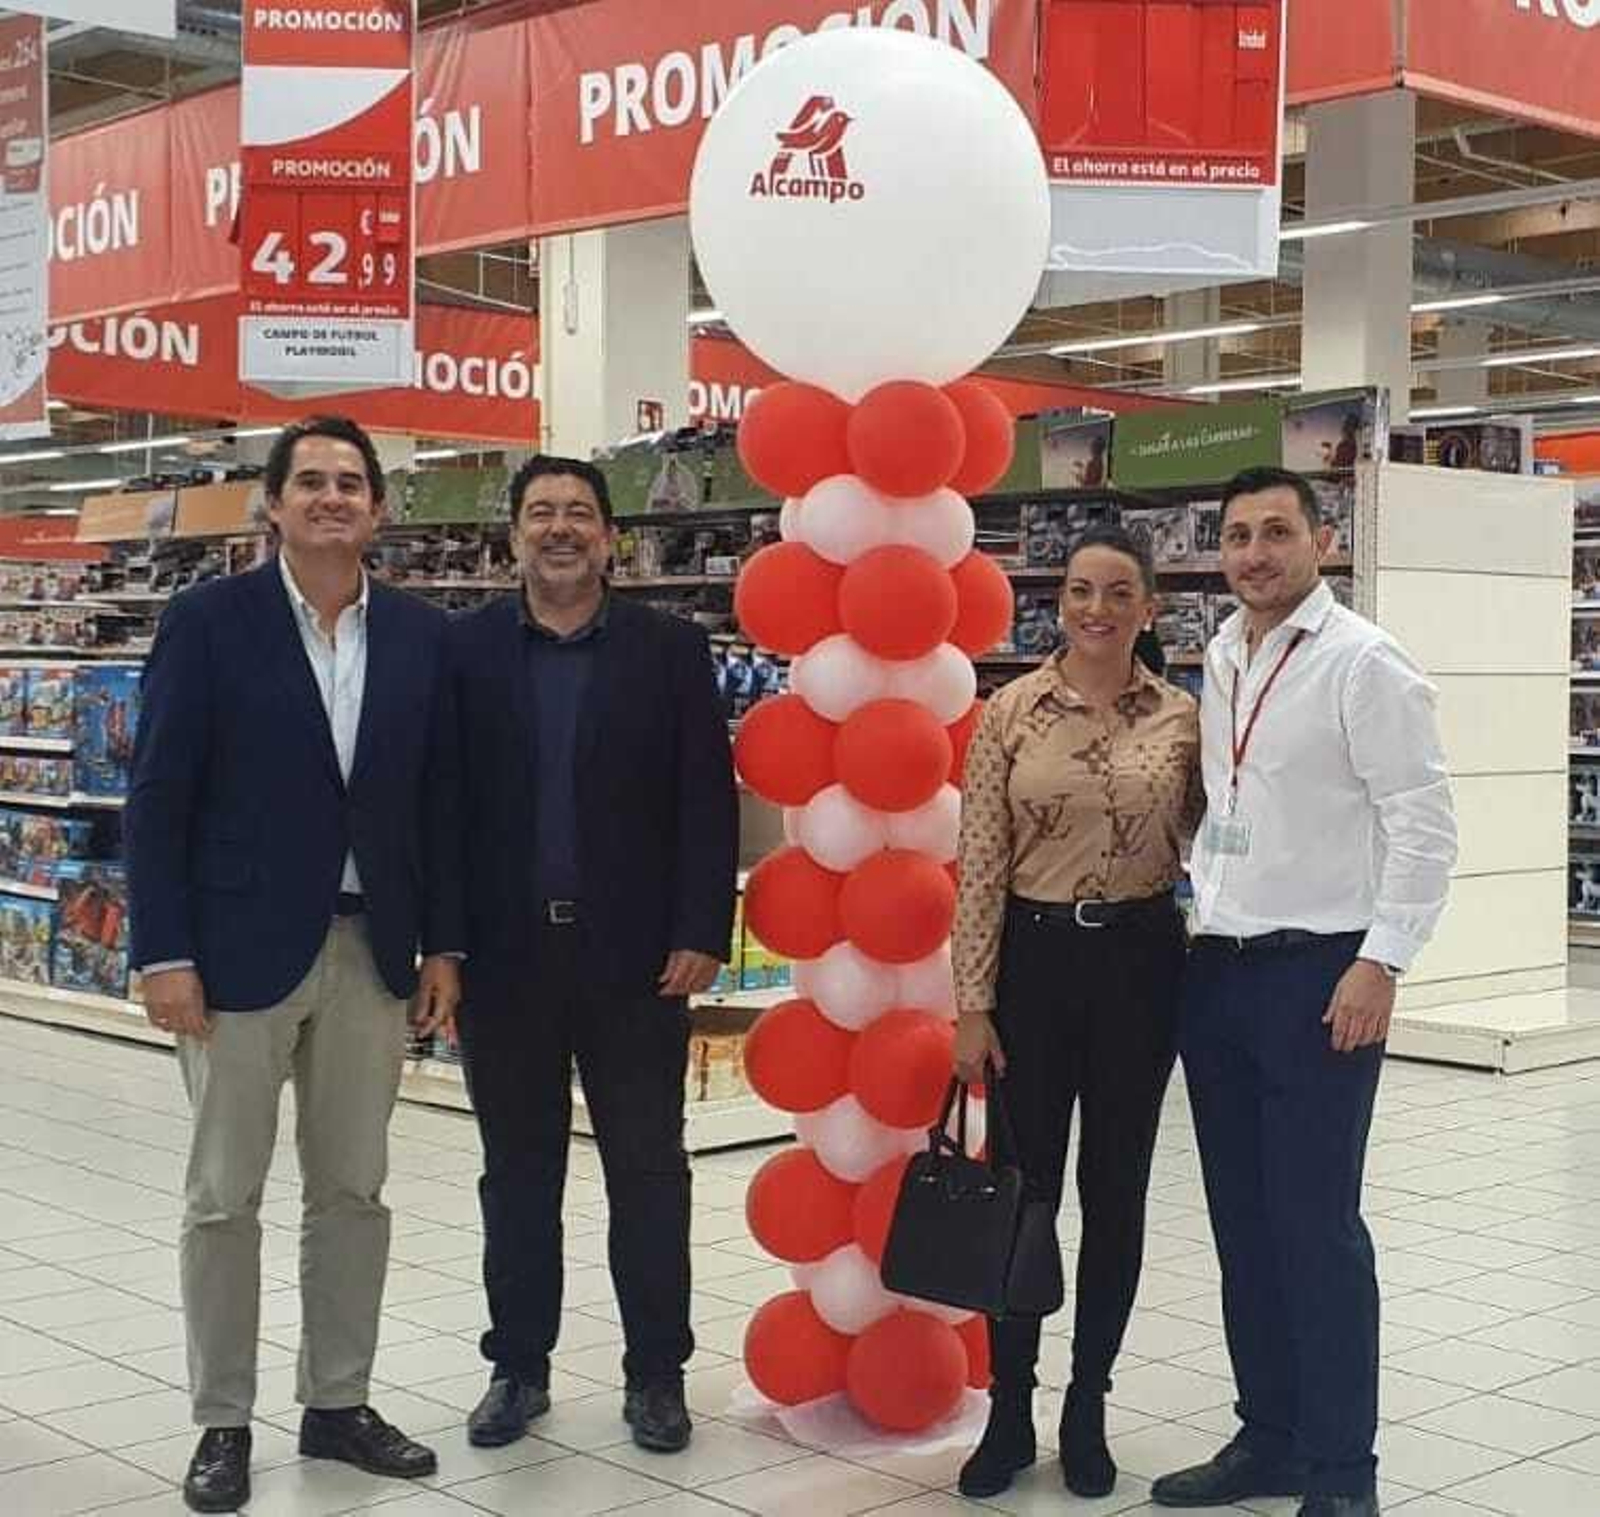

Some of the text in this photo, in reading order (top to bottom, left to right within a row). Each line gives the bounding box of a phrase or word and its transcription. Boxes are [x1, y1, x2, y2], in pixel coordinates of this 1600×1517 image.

[253, 7, 403, 32] PROMOCIÓN
[271, 157, 391, 179] PROMOCIÓN
[1053, 157, 1070, 173] El
[1168, 164, 1189, 177] en
[1210, 162, 1261, 180] precio
[750, 168, 864, 203] Alcampo
[48, 182, 139, 261] CIÓN
